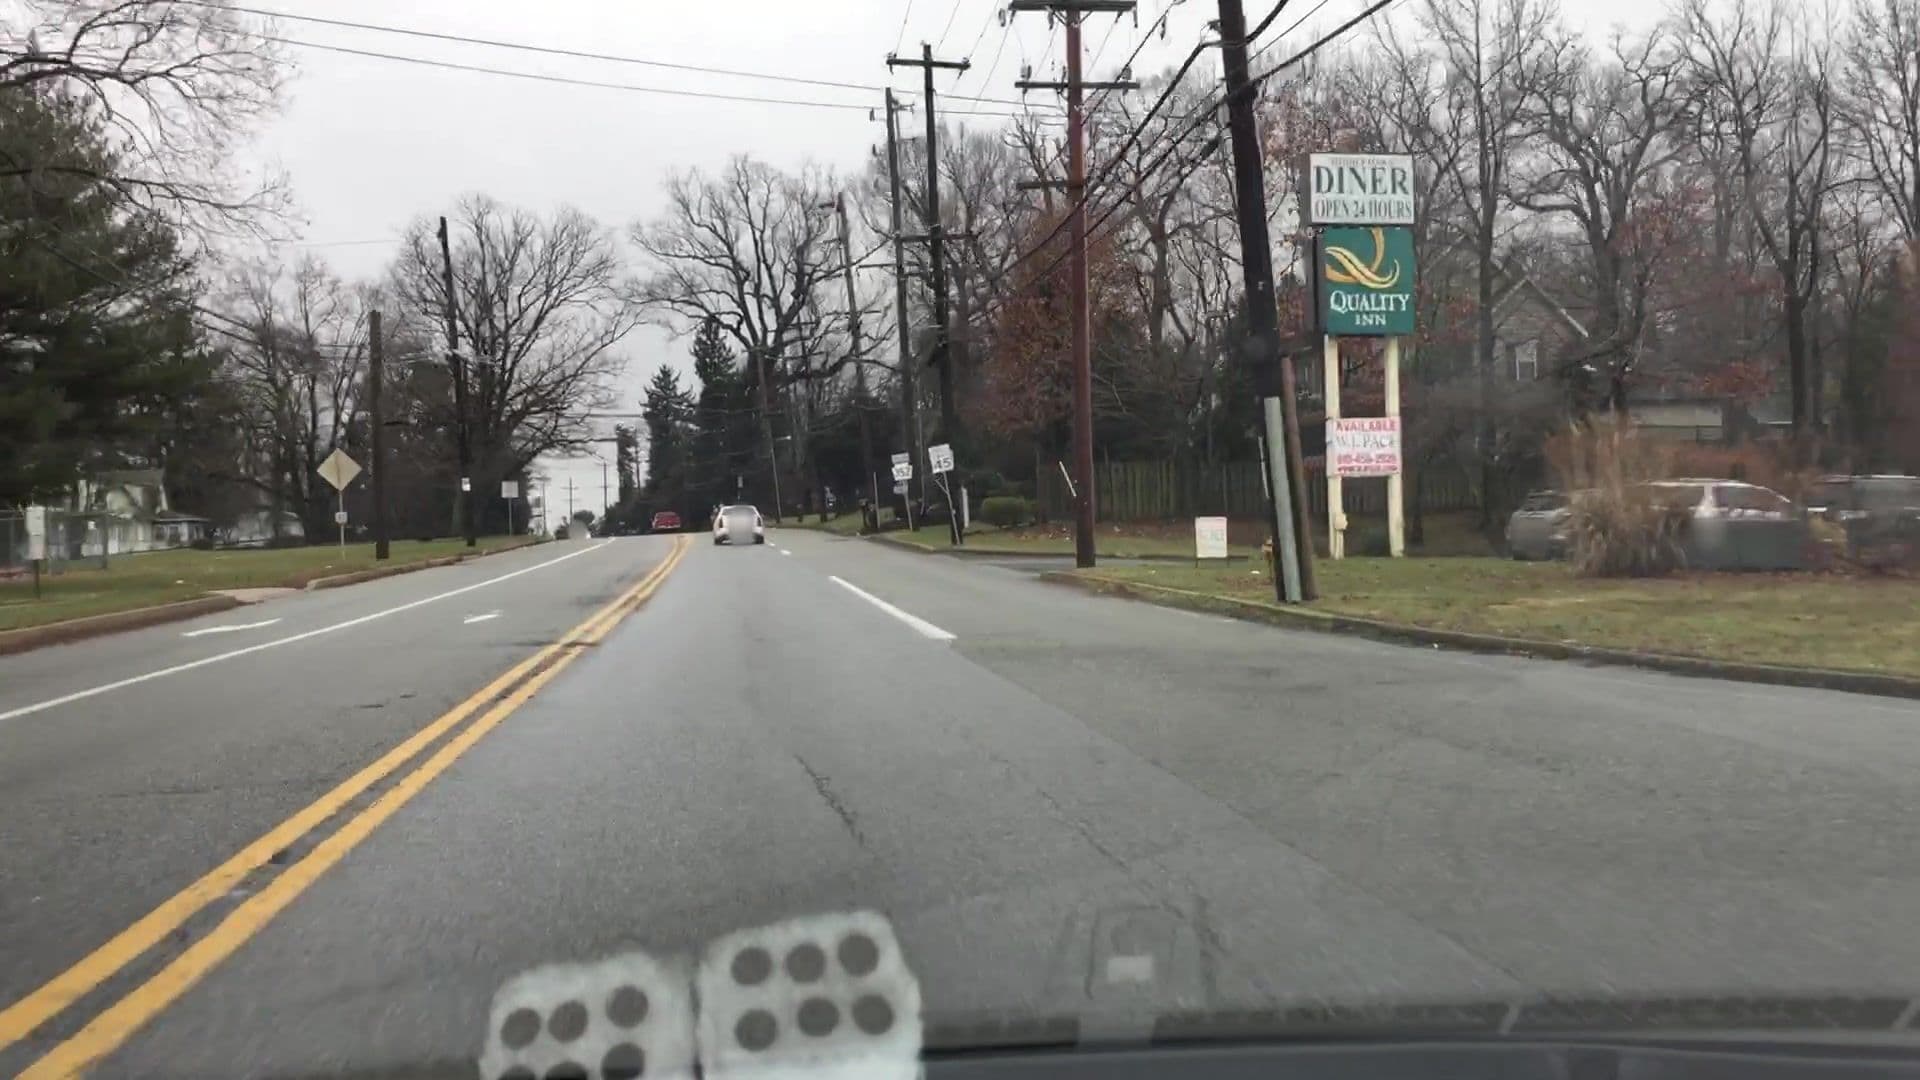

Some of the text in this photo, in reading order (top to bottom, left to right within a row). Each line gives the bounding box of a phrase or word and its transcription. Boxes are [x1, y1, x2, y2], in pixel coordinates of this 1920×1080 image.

[1314, 166, 1409, 195] DINER
[1315, 199, 1412, 218] OPEN 24 HOURS
[1330, 290, 1410, 314] QUALITY
[1354, 313, 1387, 326] INN
[1336, 420, 1396, 432] AVAILABLE
[934, 456, 952, 471] 45
